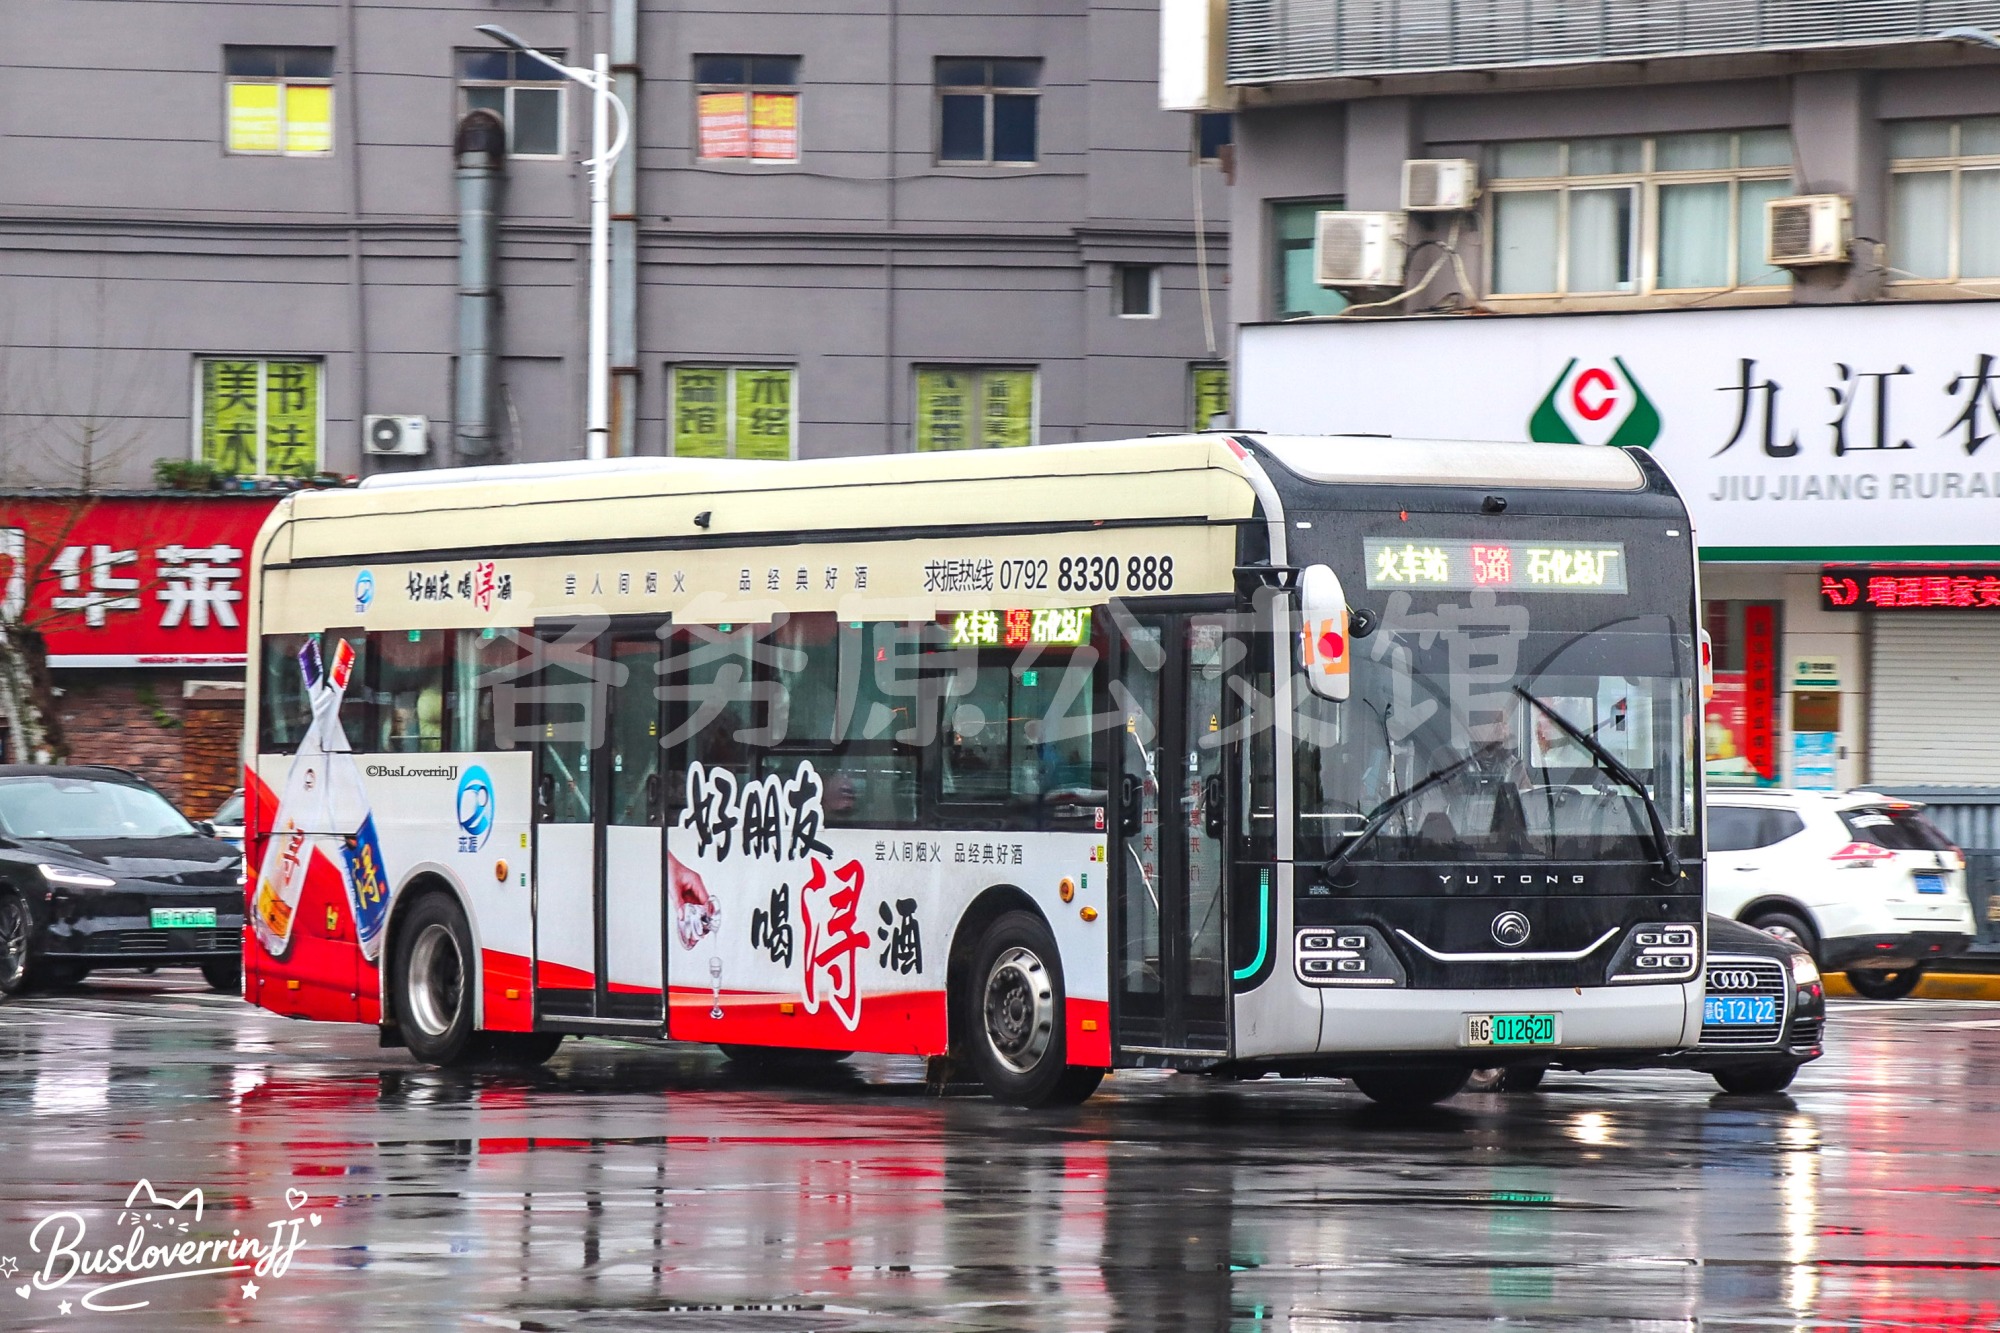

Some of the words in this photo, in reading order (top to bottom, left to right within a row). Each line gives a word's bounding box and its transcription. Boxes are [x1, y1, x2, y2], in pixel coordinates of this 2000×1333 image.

[1709, 353, 2000, 459] 九江农
[1709, 473, 1880, 501] JIUJIANG
[564, 570, 686, 595] 尝人间烟火
[738, 566, 868, 591] 品经典好酒
[924, 558, 994, 592] 求振热线
[1000, 559, 1048, 590] 0792
[1057, 556, 1120, 592] 8330
[1126, 555, 1174, 591] 888
[1376, 545, 1449, 583] 火车站
[1472, 546, 1512, 584] 5路
[1526, 548, 1619, 585] 石化总厂
[49, 543, 244, 628] 华莱
[951, 609, 1000, 645] 火车站
[1005, 608, 1032, 645] 5路
[1032, 607, 1092, 644] 石化总厂
[680, 762, 834, 863] 好朋友
[874, 840, 942, 863] 尝人间烟火
[954, 842, 1024, 866] 品经典好酒
[1438, 875, 1585, 885] YUTONG
